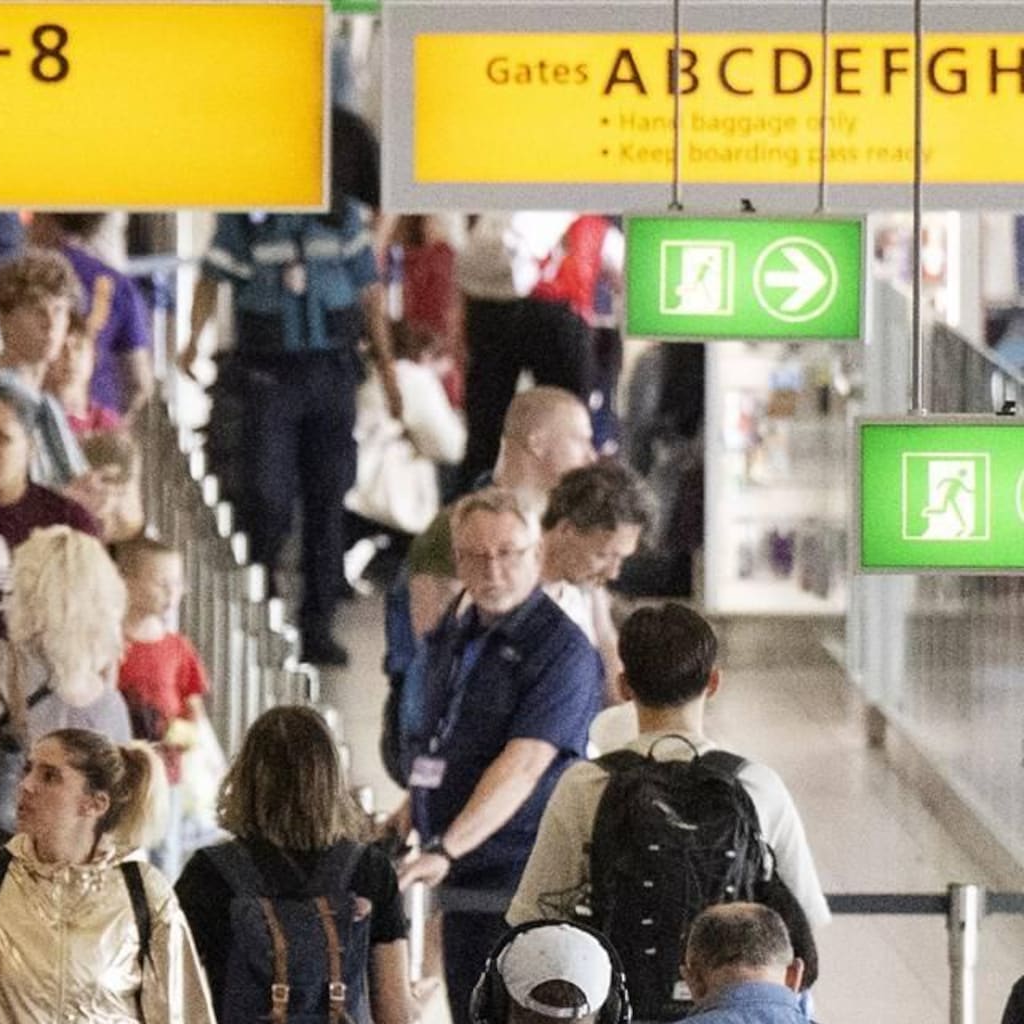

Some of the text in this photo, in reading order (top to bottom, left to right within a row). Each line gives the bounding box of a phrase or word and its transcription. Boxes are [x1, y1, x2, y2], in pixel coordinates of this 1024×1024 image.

[486, 56, 590, 86] Gates
[691, 111, 796, 136] baggage
[688, 141, 799, 168] boarding
